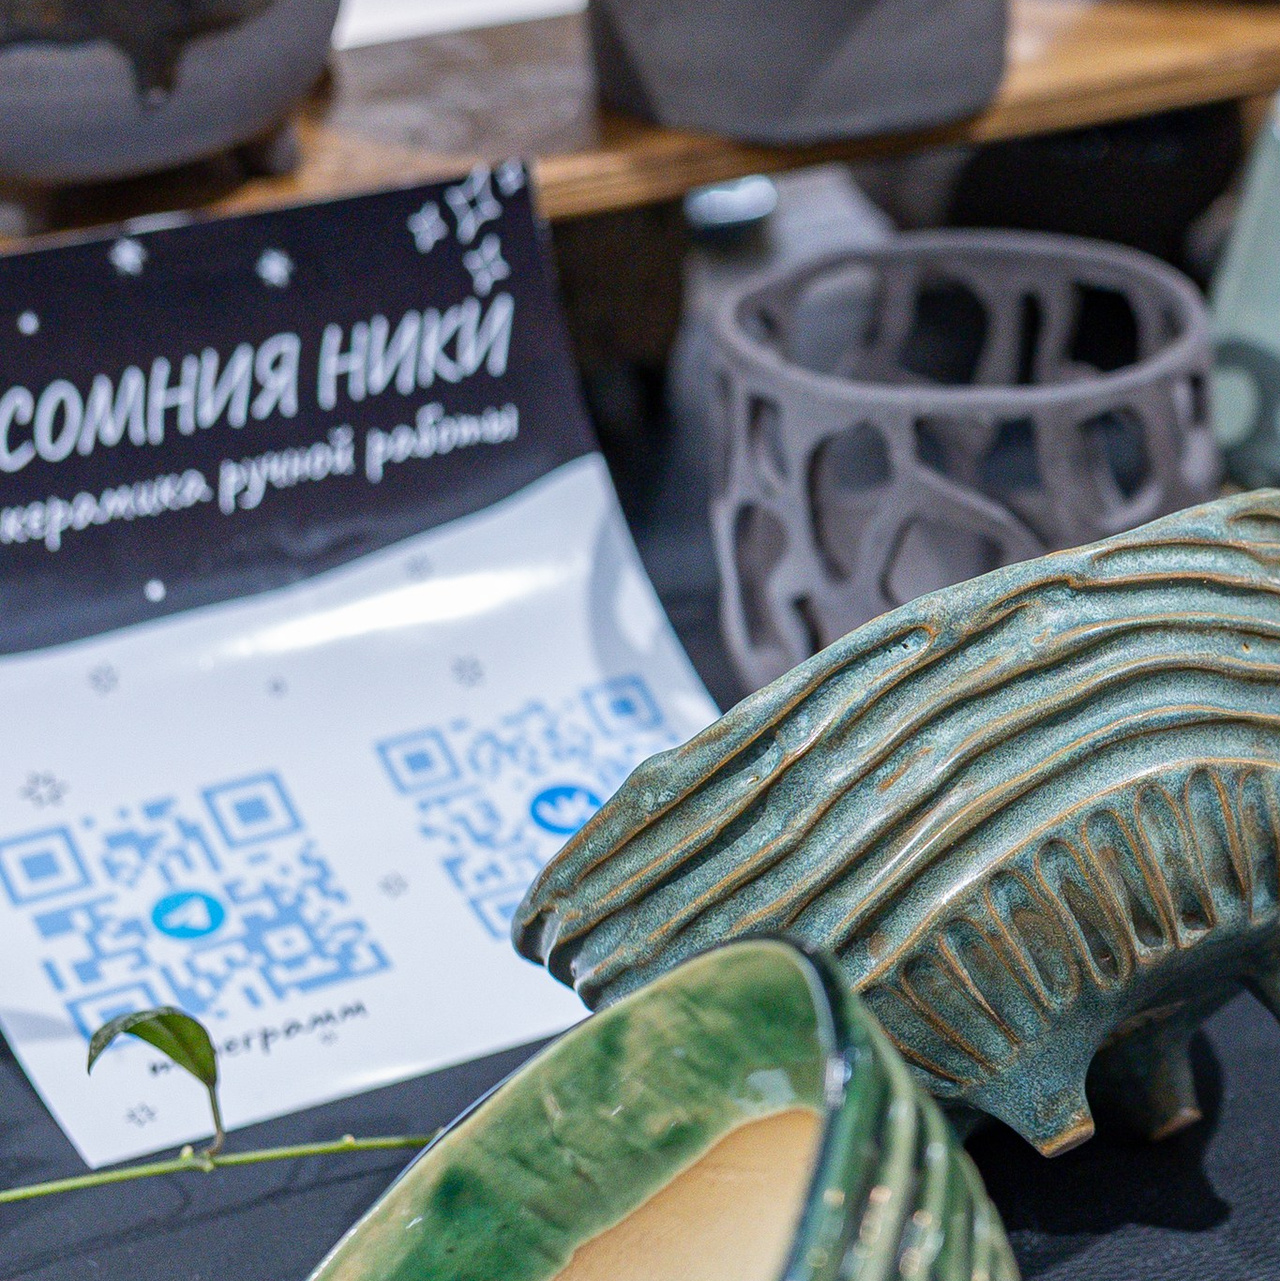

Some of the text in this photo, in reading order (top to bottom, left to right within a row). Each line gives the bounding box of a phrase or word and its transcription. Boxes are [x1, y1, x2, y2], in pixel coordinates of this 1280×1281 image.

[0, 291, 515, 473] СОМНИЯ НИКИ
[0, 402, 519, 552] керамика ручной работы
